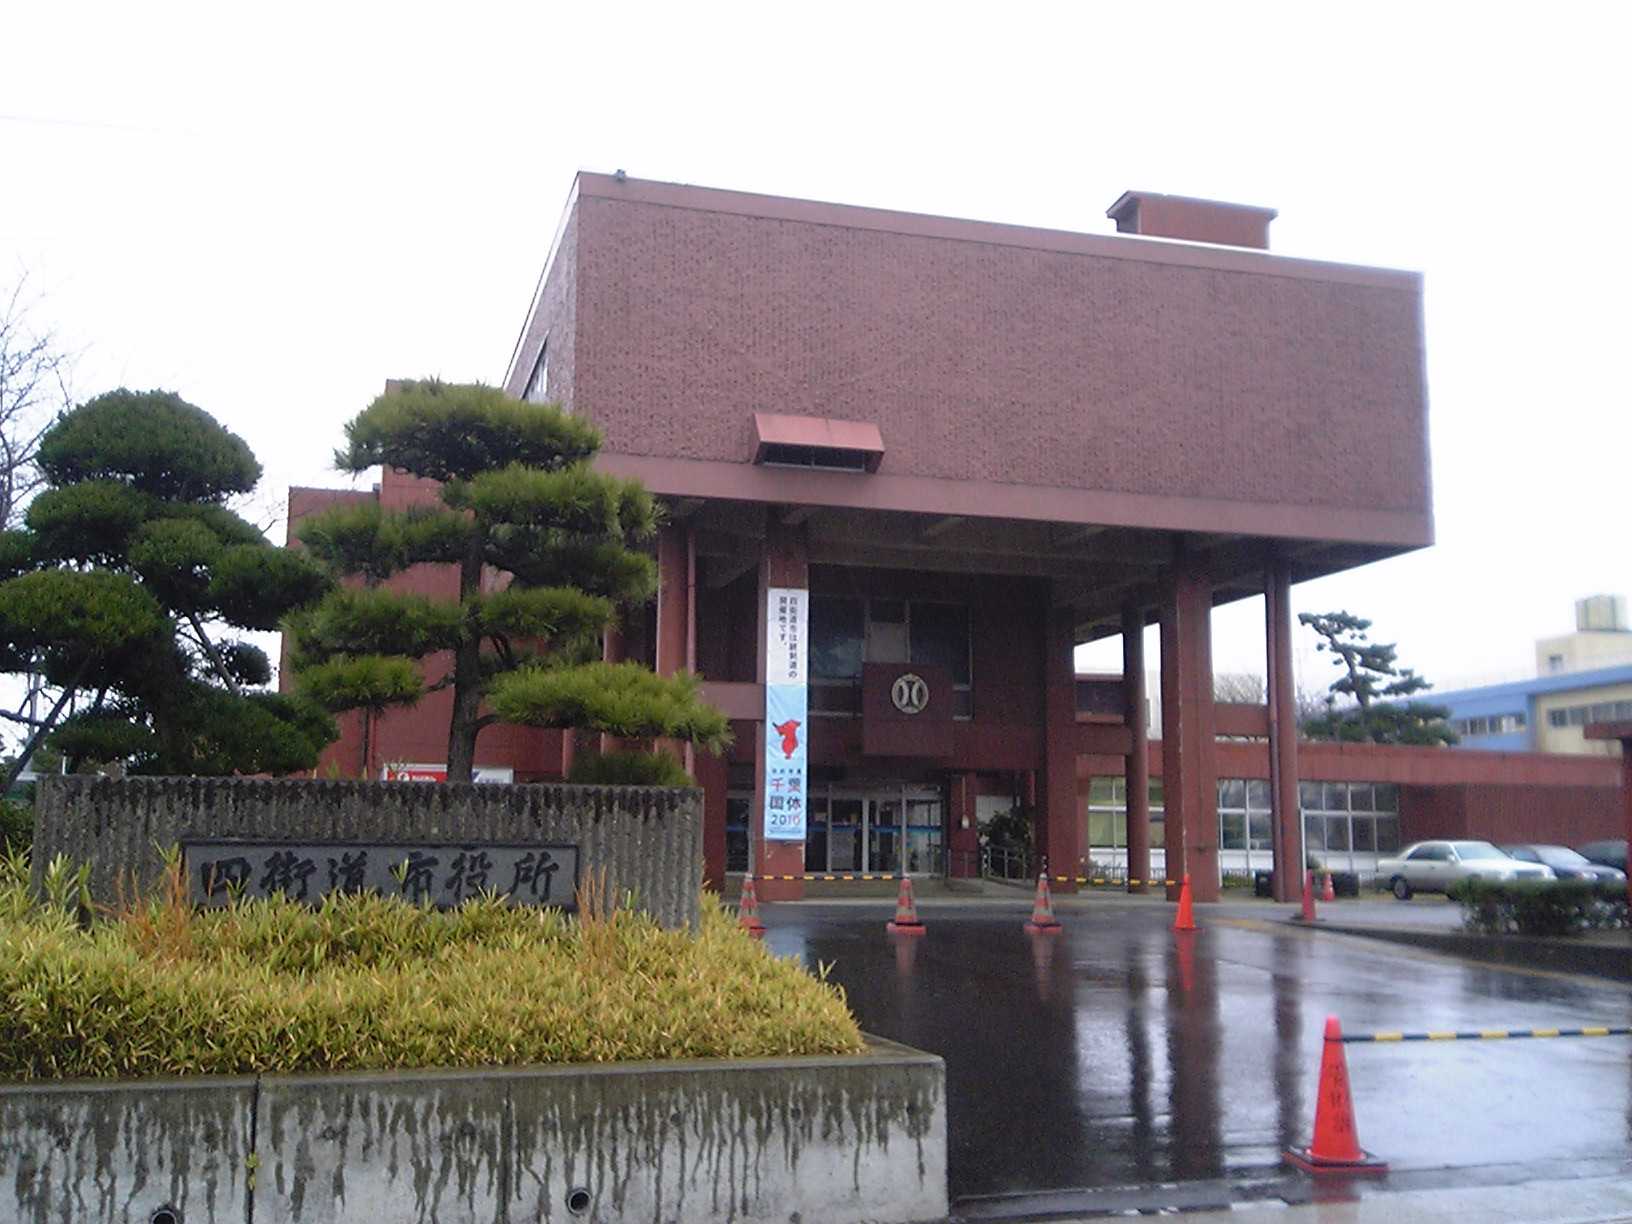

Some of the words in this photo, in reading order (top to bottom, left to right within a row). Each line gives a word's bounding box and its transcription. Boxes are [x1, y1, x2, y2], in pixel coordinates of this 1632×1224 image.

[771, 777, 801, 793] 千葉
[771, 814, 801, 826] 2010
[201, 850, 560, 901] 四街道市役所
